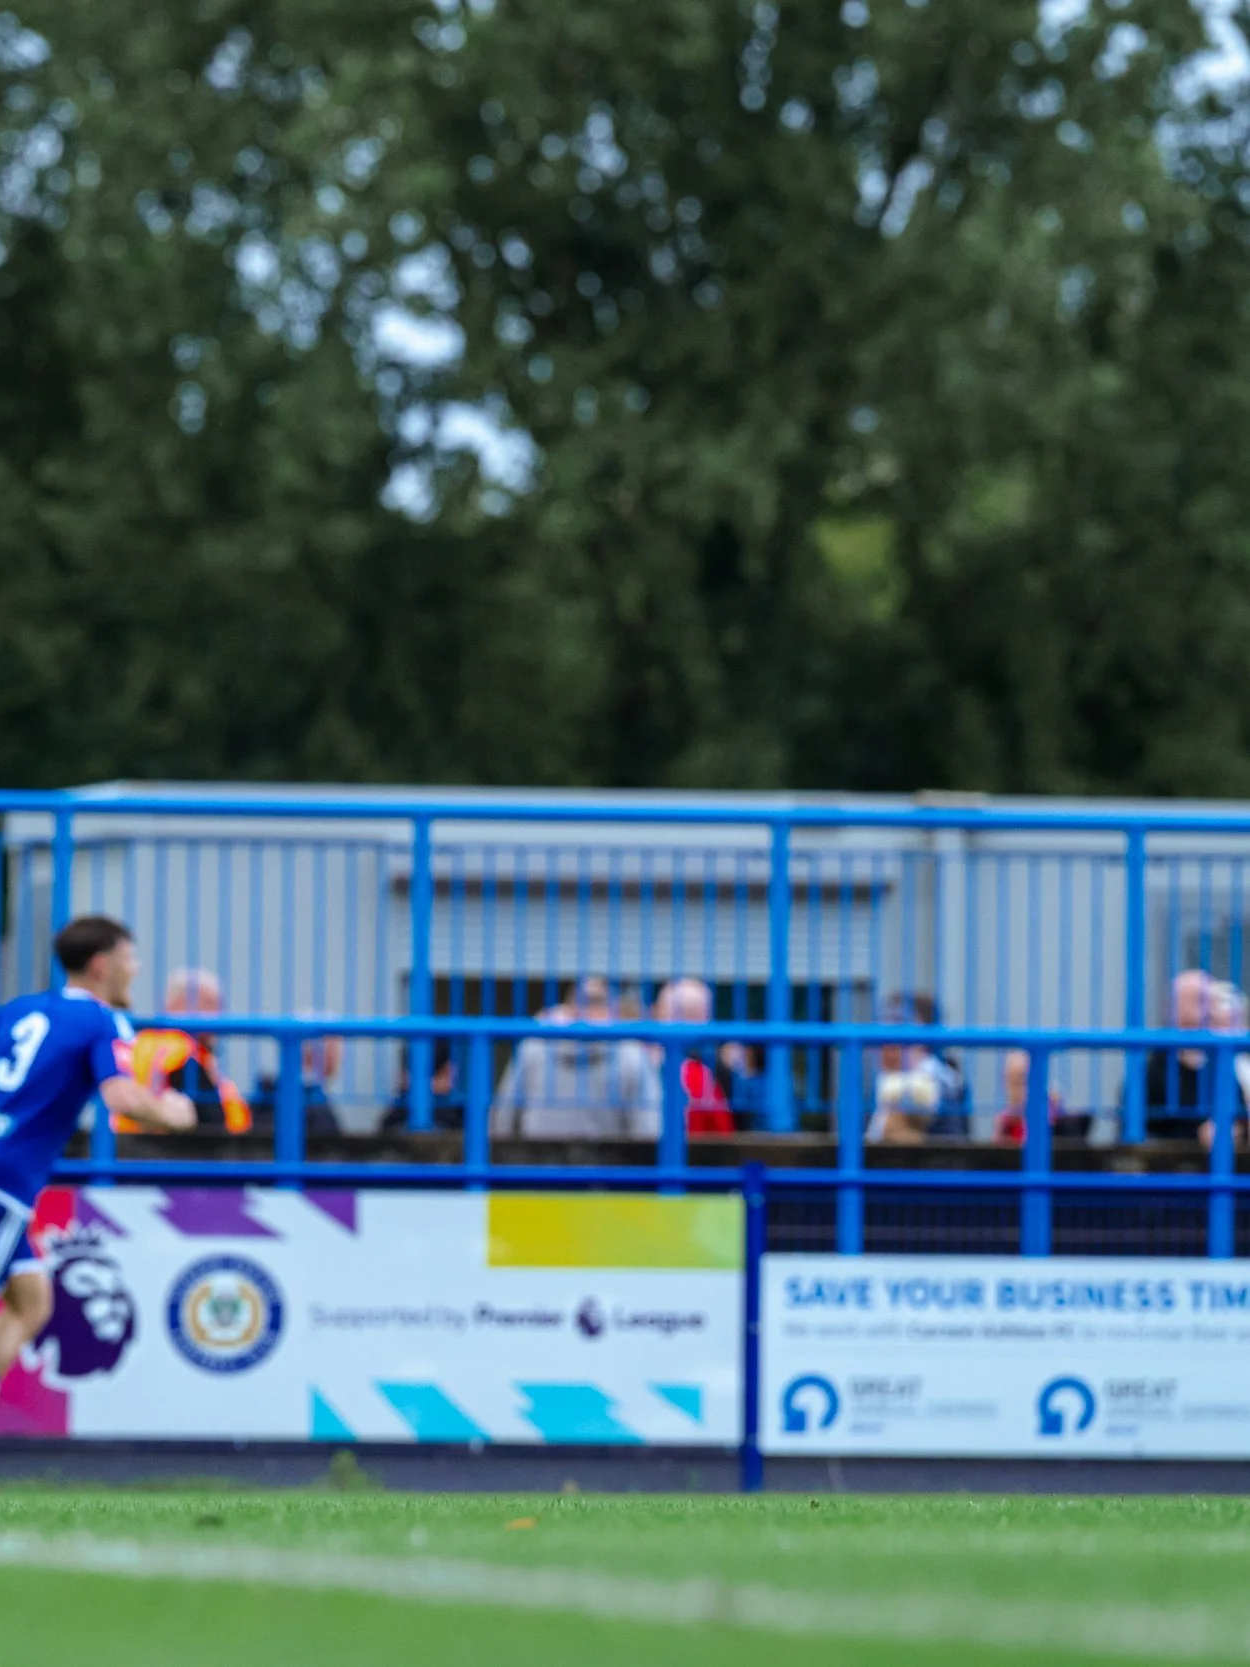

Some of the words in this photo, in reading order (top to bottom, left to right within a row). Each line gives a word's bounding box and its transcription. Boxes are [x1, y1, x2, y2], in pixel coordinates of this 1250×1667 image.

[783, 1275, 873, 1310] SAVE
[884, 1276, 985, 1311] YOUR
[996, 1277, 1176, 1314] BUSINESS
[472, 1301, 562, 1328] Premier
[613, 1304, 707, 1338] League
